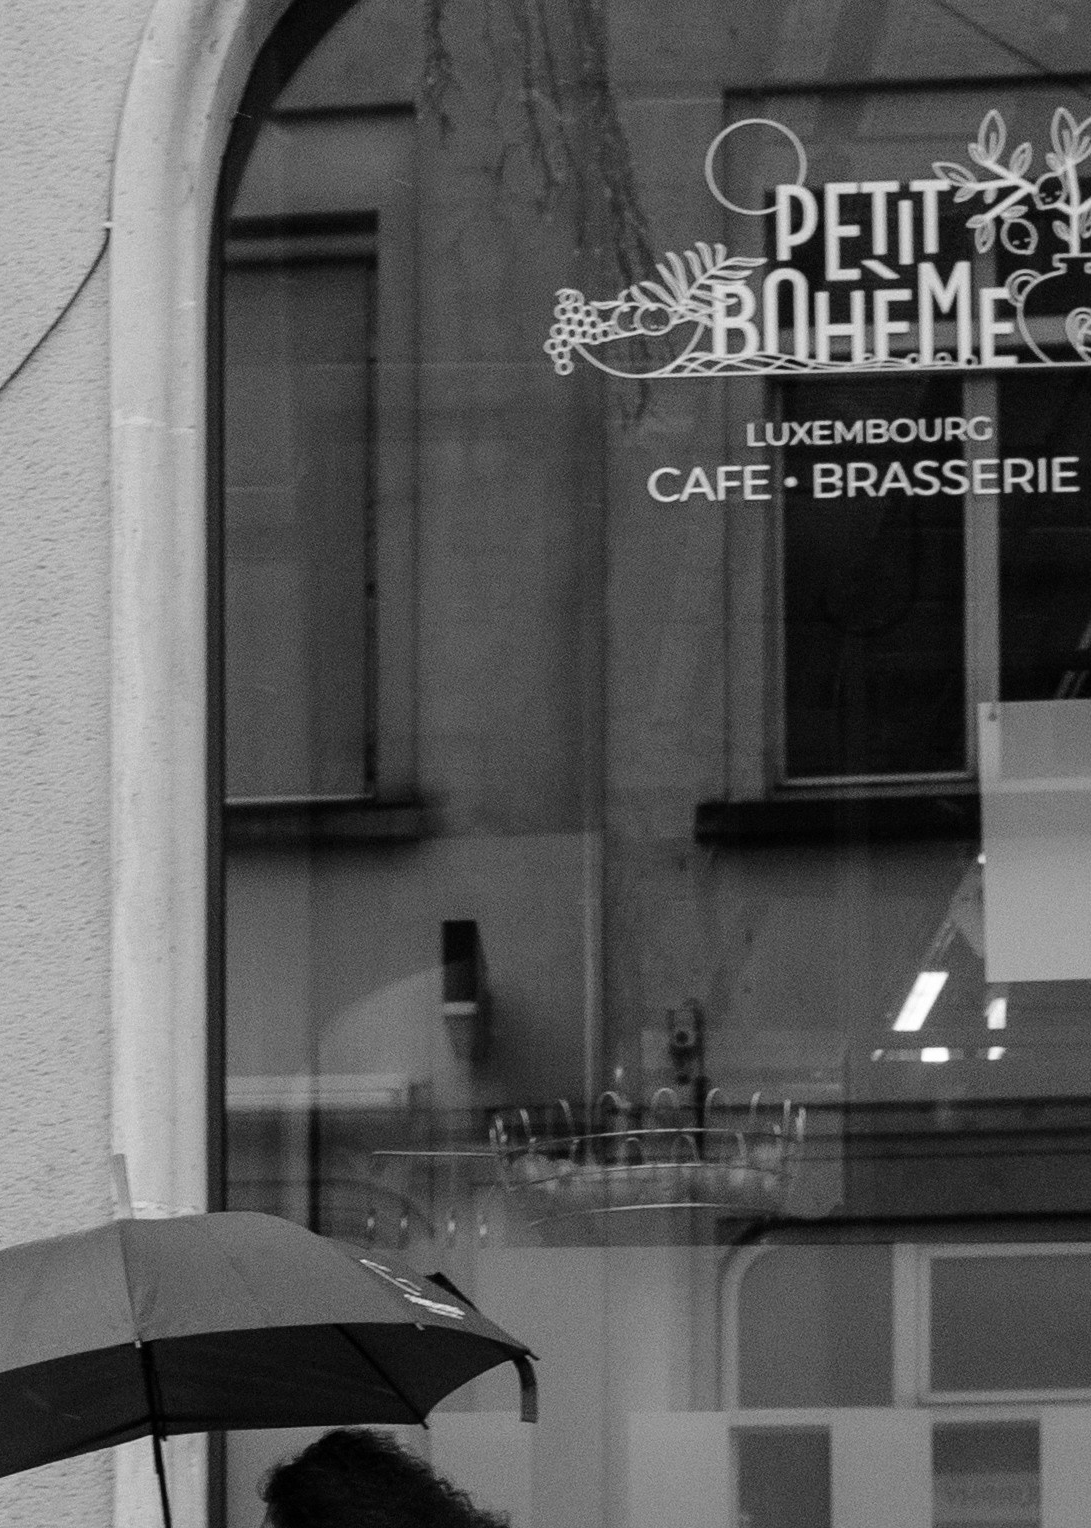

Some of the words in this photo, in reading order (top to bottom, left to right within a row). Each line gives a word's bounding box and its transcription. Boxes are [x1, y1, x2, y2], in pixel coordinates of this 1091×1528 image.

[775, 178, 952, 281] PETIT
[745, 414, 994, 448] LUXEMBOURG
[646, 464, 773, 503] CAFE
[811, 456, 1081, 499] BRASSERIE
